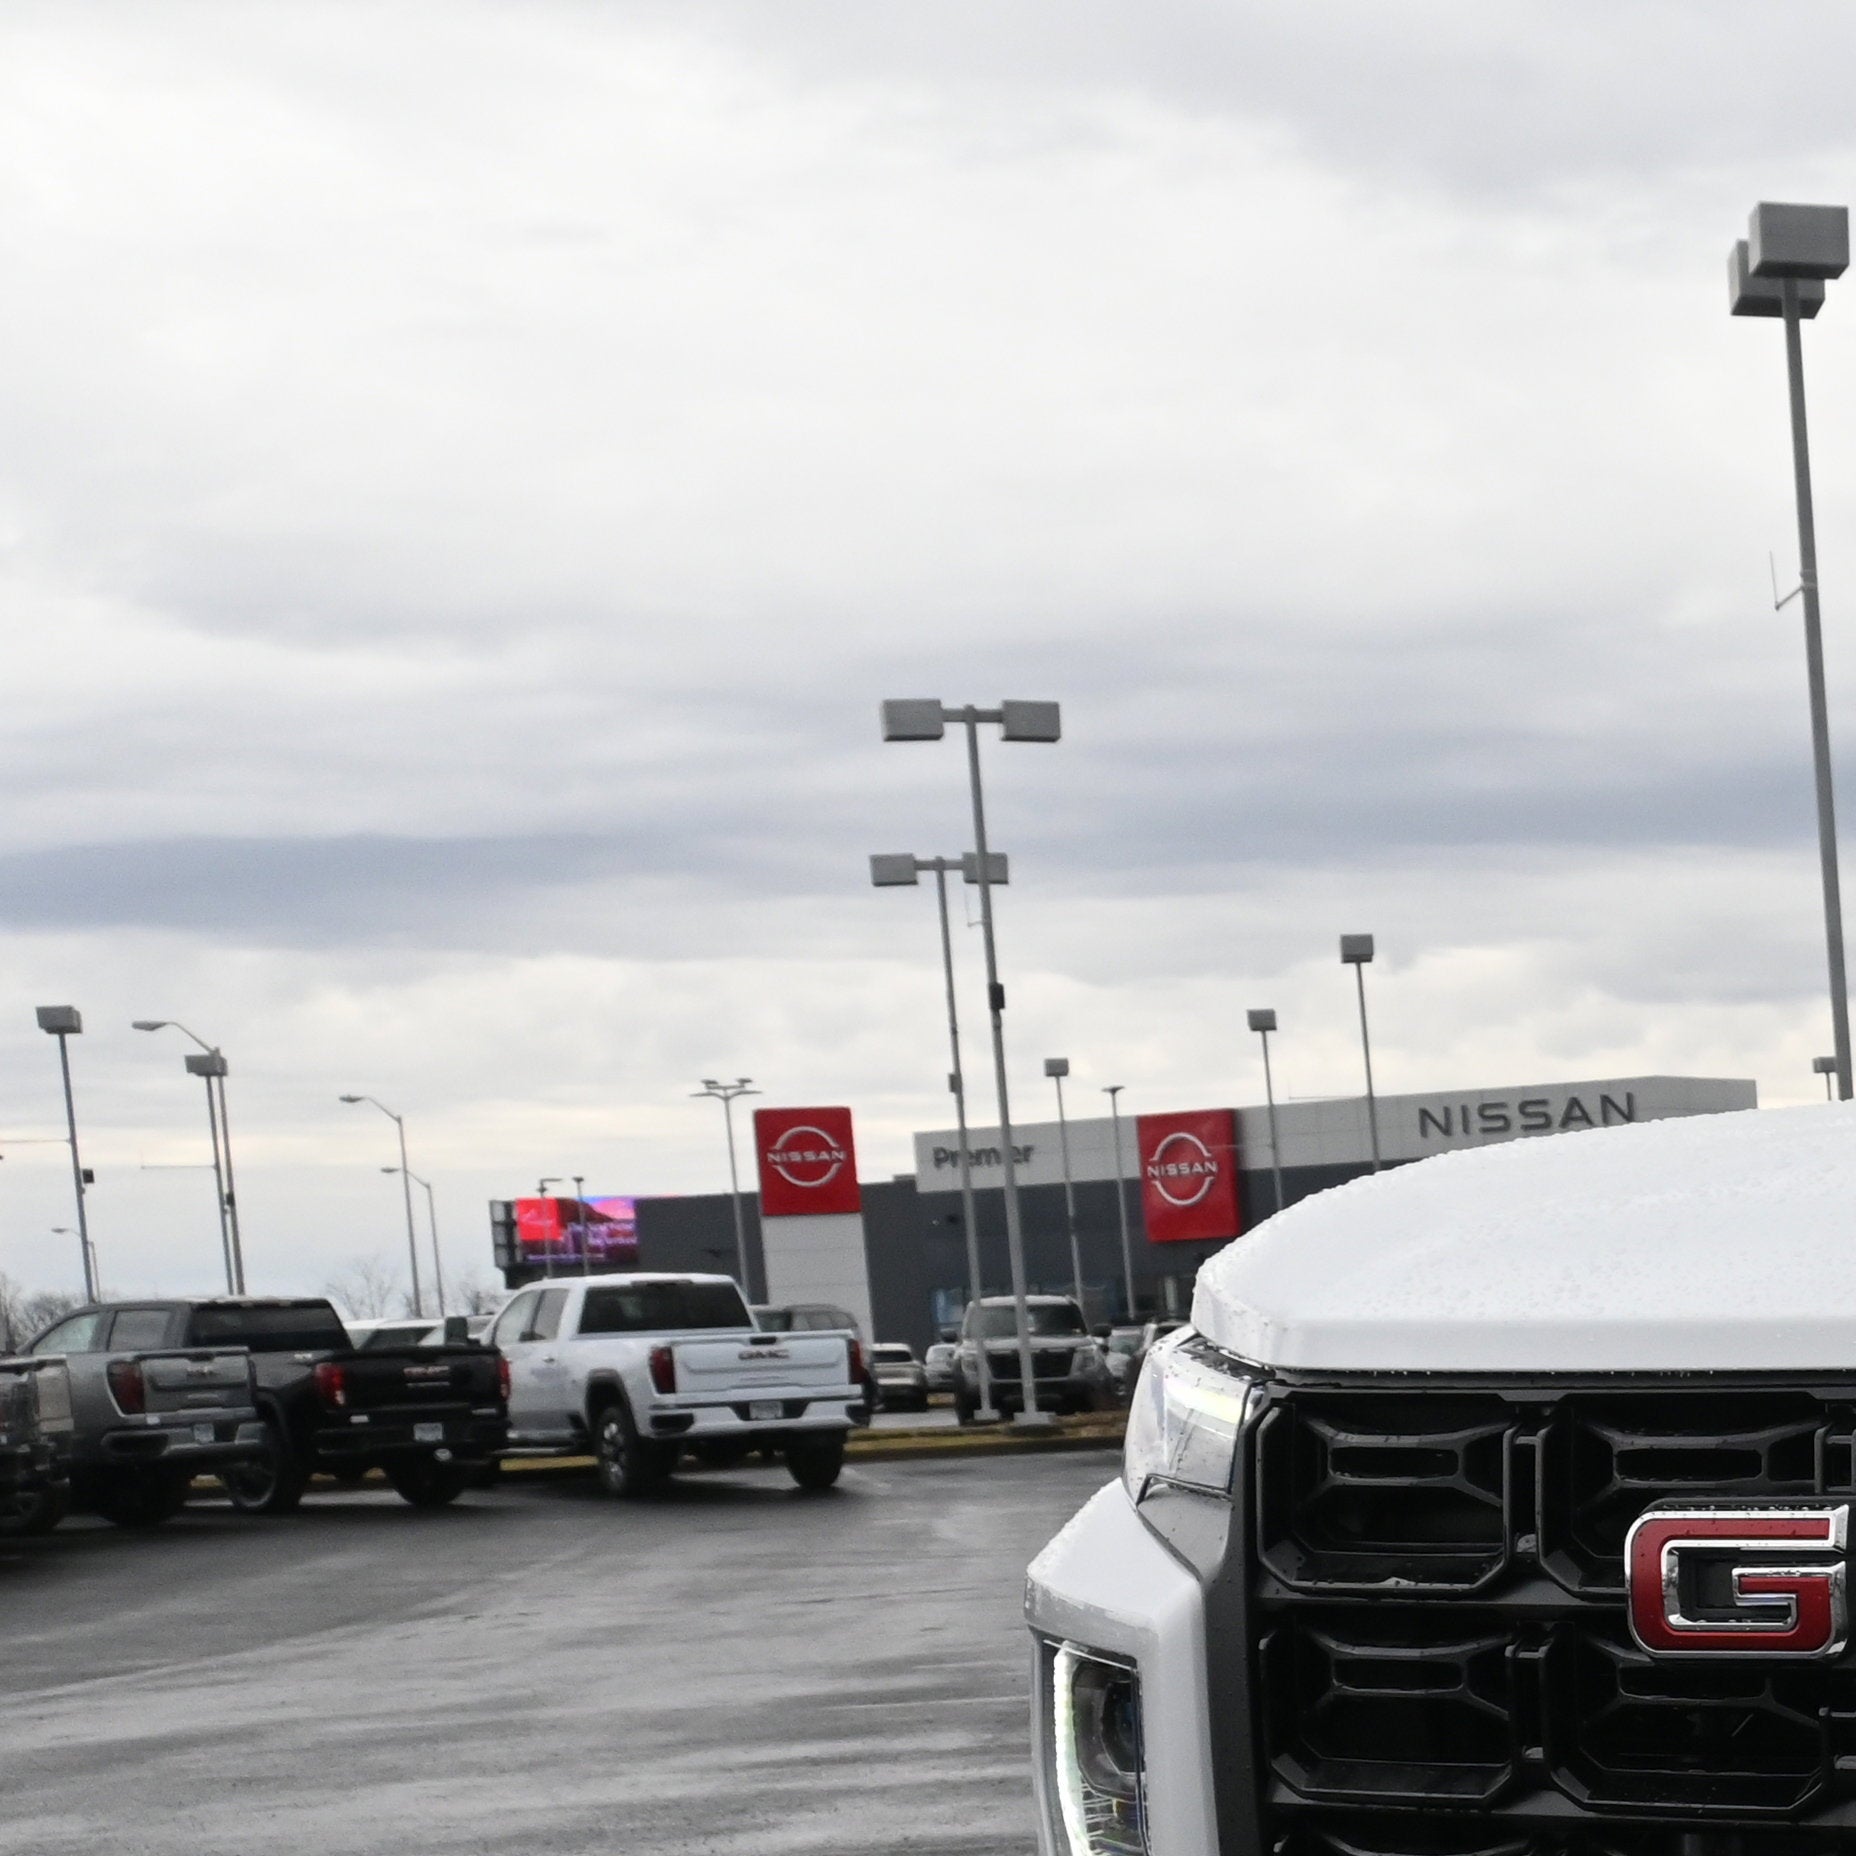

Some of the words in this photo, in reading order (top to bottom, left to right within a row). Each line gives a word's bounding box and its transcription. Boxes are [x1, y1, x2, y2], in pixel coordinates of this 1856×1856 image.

[1418, 1092, 1637, 1139] NISSAN
[767, 1150, 846, 1163] NISSAN
[1147, 1160, 1219, 1178] NISSAN
